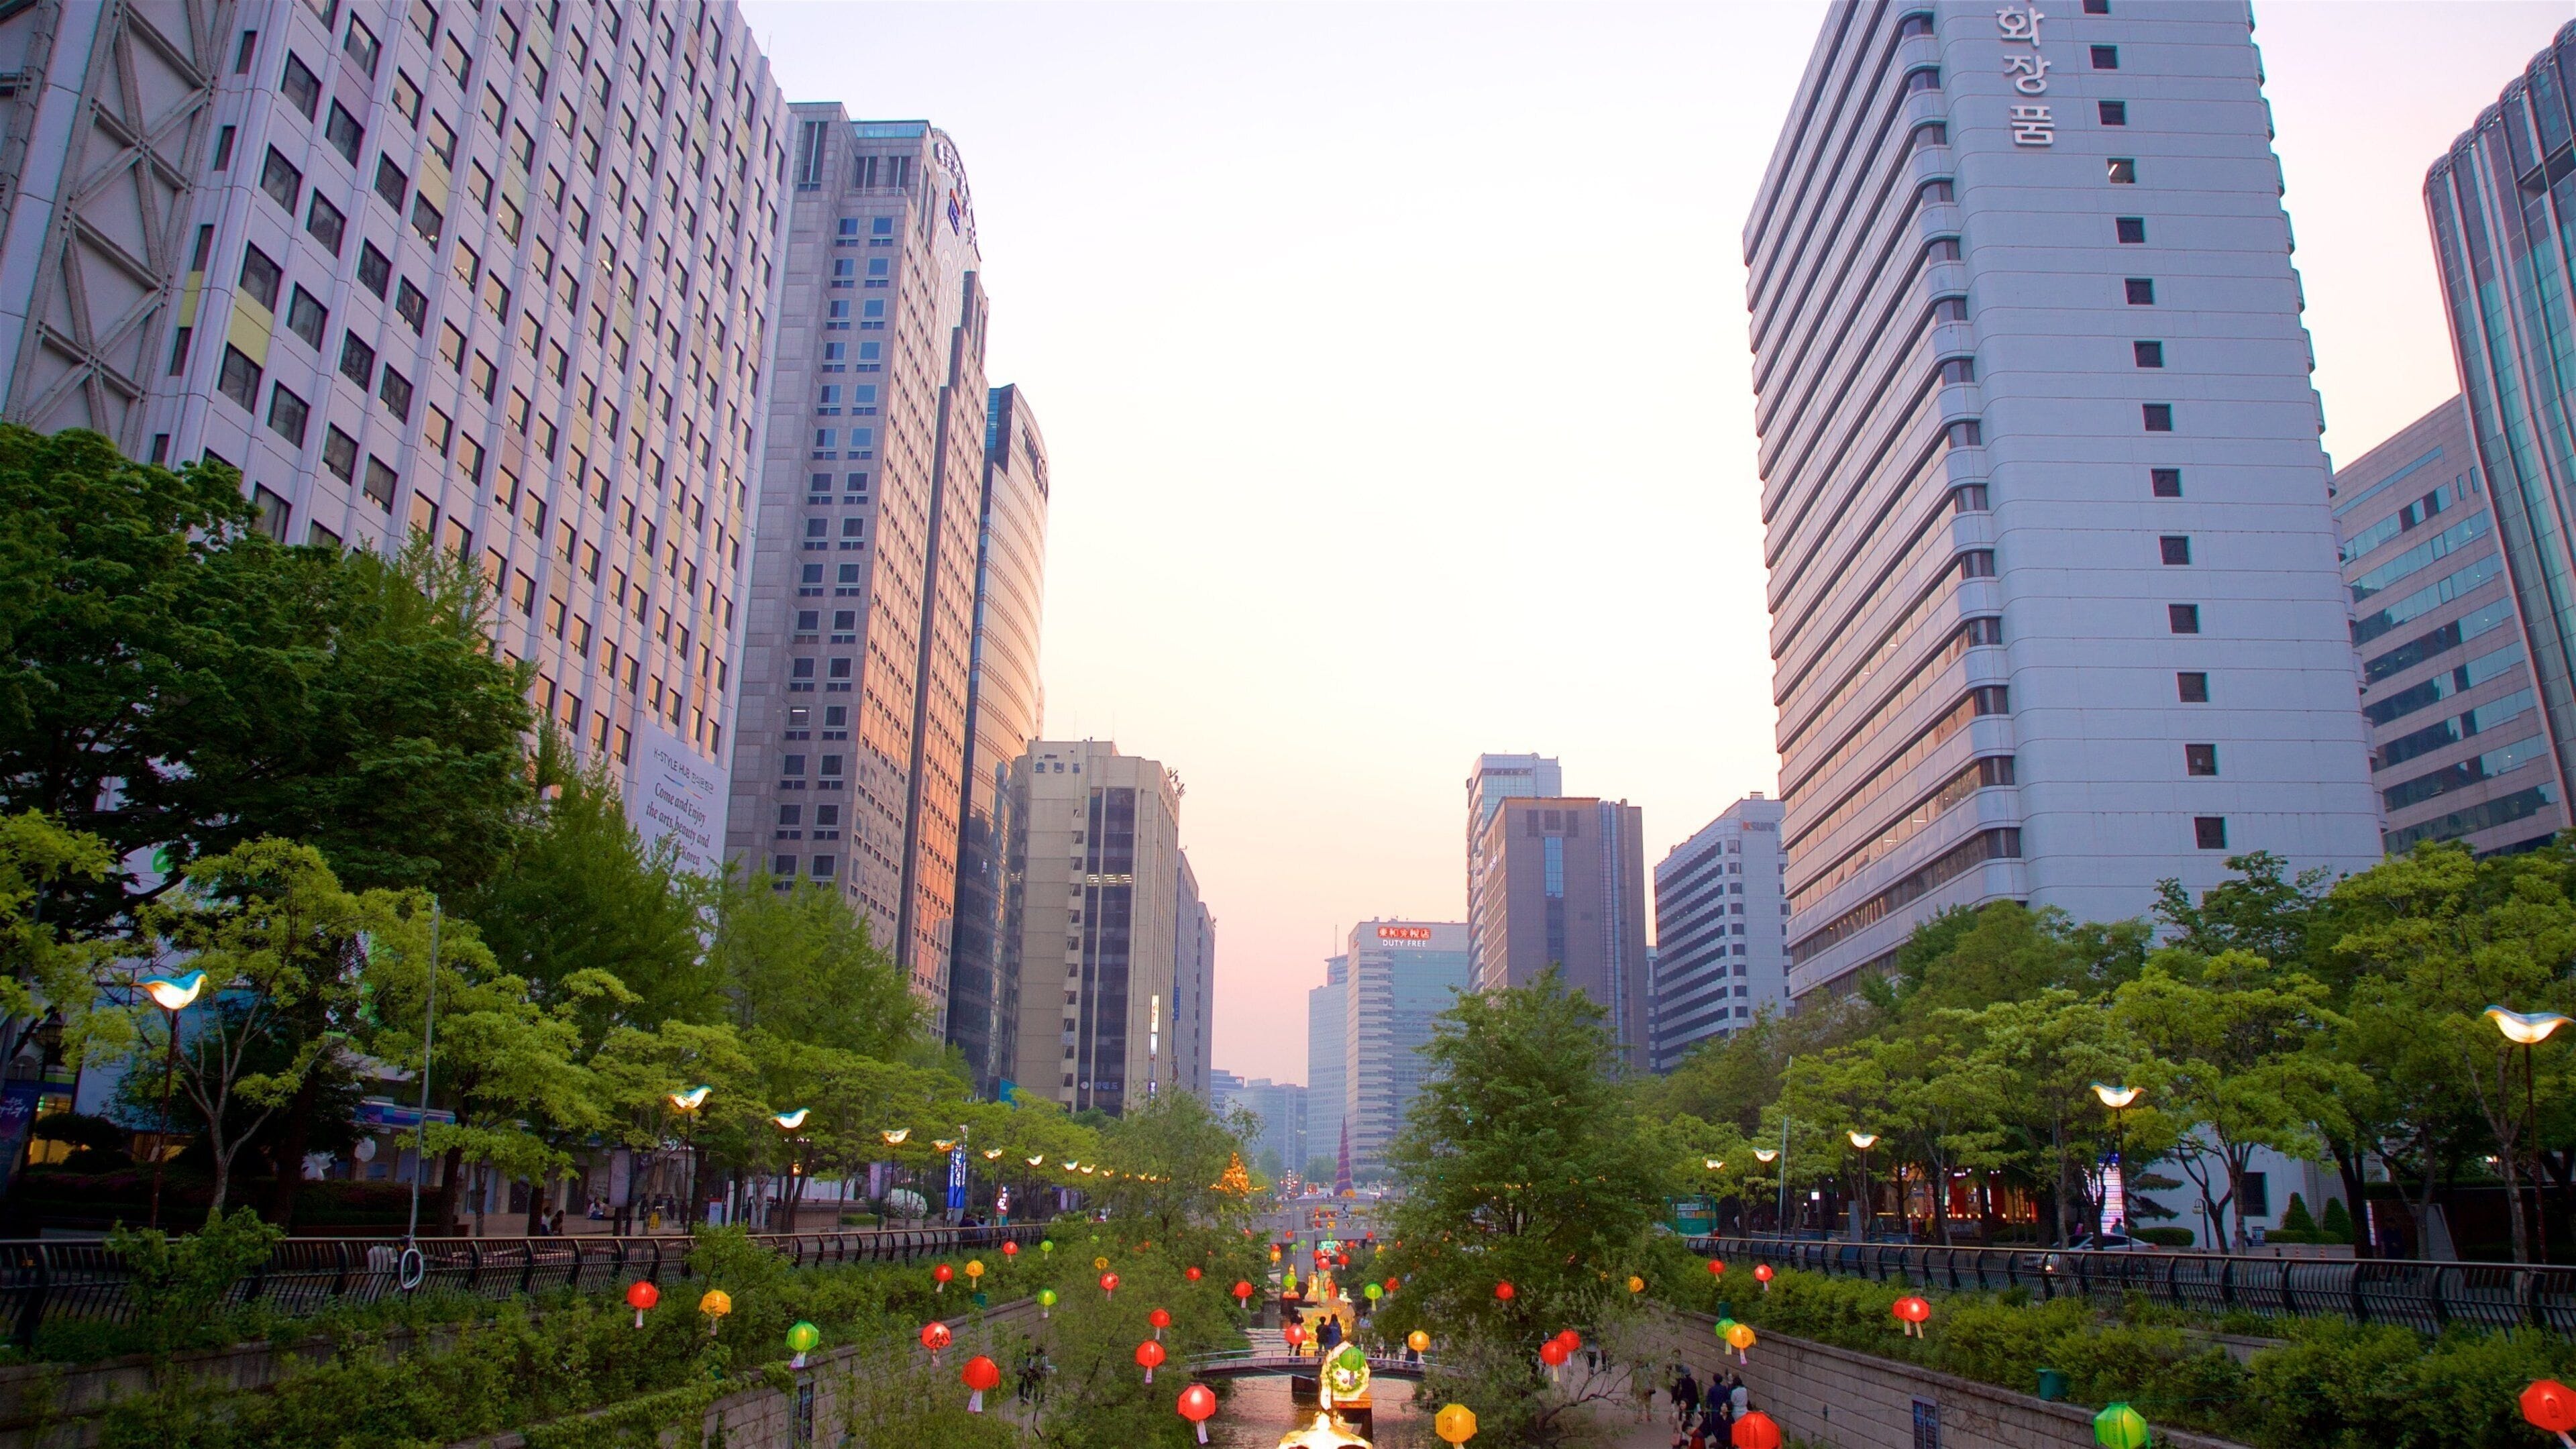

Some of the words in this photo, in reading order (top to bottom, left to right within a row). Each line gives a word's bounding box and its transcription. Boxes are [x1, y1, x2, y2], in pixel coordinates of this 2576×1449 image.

[653, 747, 678, 771] K-STYLE
[679, 763, 690, 779] HUB
[655, 782, 674, 805] Come
[675, 798, 689, 814] and
[688, 804, 706, 828] Enjoy
[646, 801, 658, 819] the
[675, 816, 696, 845] beauty
[697, 834, 710, 849] and
[681, 845, 700, 866] Korea
